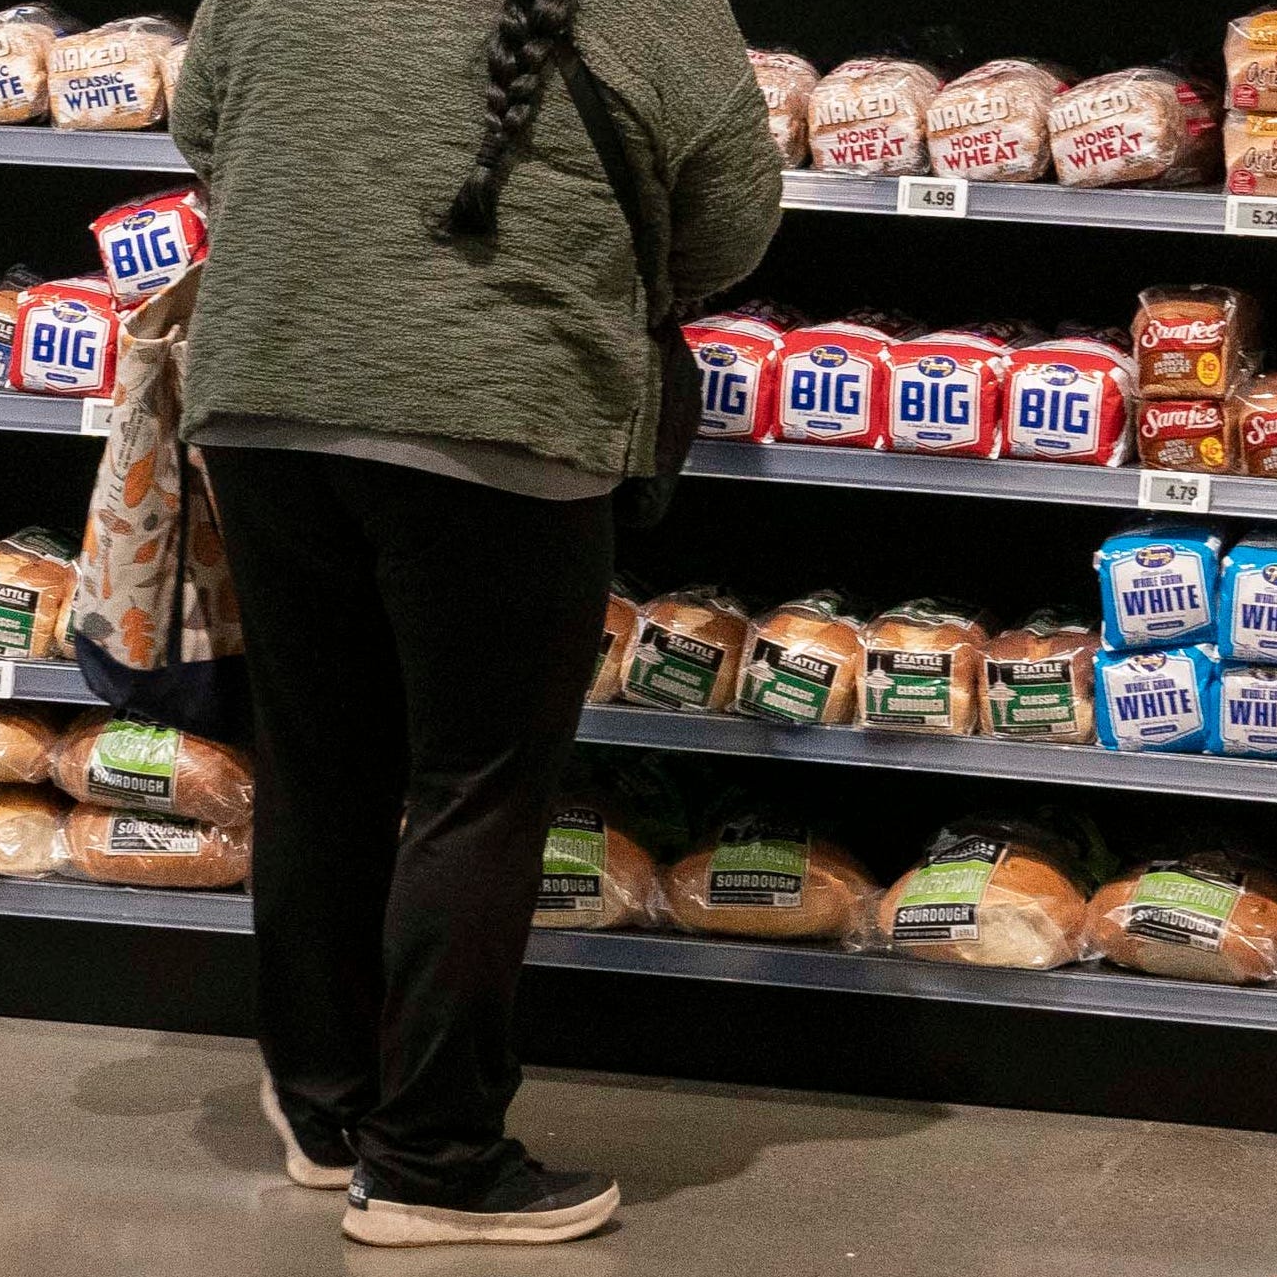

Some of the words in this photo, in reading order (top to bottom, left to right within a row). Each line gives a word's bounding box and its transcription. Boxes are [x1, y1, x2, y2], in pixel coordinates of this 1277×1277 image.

[837, 126, 889, 146] HONEY
[950, 130, 1003, 151] HONEY
[829, 139, 906, 166] WHEAT
[942, 140, 1020, 169] WHEAT
[923, 191, 955, 208] 4.99
[110, 227, 181, 280] BIG
[32, 323, 97, 371] BIG
[790, 370, 862, 414] BIG
[900, 380, 970, 426] BIG
[1019, 388, 1090, 434] BIG
[1165, 484, 1198, 501] 4.79
[1123, 585, 1199, 617] WHITE
